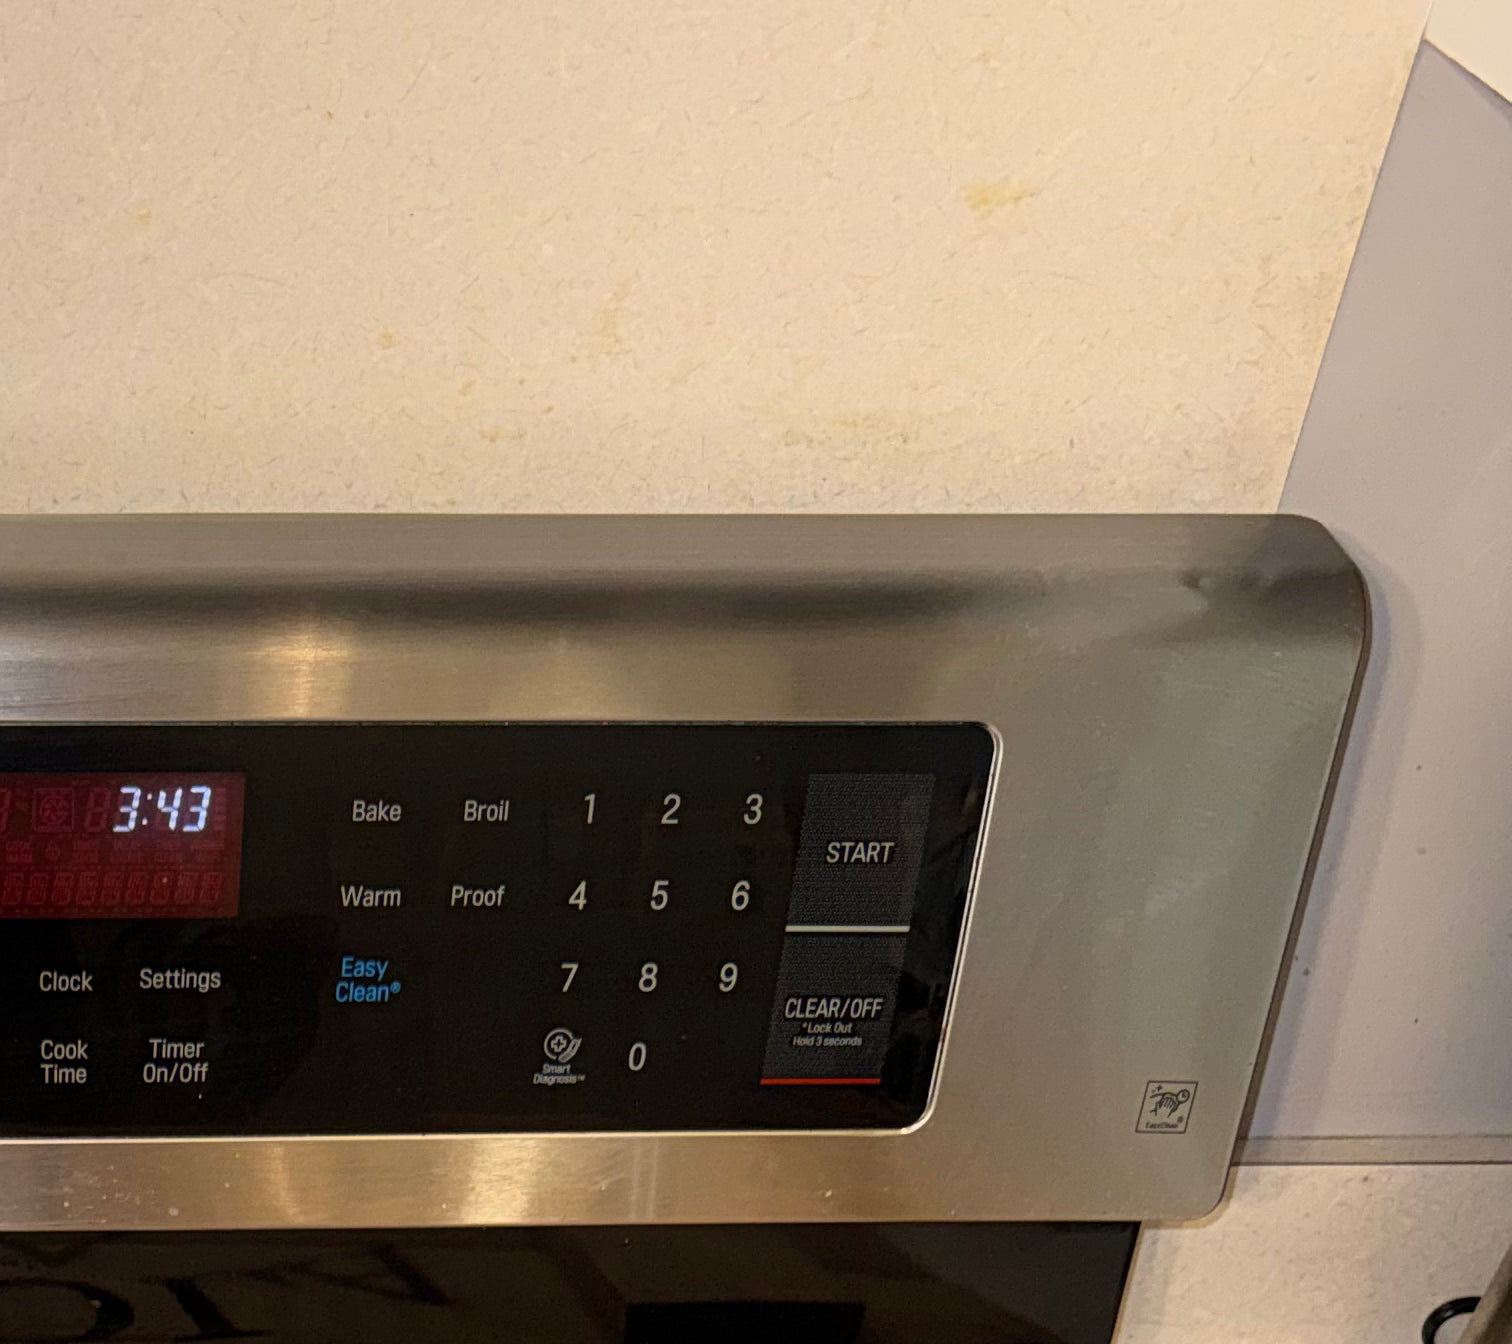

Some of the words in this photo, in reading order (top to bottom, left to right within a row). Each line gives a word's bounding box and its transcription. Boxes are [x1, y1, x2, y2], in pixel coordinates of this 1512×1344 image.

[113, 786, 211, 832] 3:43
[352, 800, 402, 822] Bake
[463, 800, 510, 822] Broil
[584, 794, 596, 825] 1
[660, 794, 682, 825] 2
[743, 794, 763, 825] 3
[826, 841, 895, 863] START
[340, 885, 401, 907] Warm
[451, 885, 506, 907] Proof
[568, 880, 587, 911] 4
[650, 880, 669, 911] 5
[731, 880, 750, 911] 6
[341, 956, 389, 981] Easy
[561, 962, 579, 992] 7
[638, 962, 658, 993] 8
[718, 962, 738, 993] 9
[39, 970, 93, 992] Clock
[140, 968, 221, 993] Settings
[785, 998, 884, 1018] CLEAR/OFF
[834, 1022, 853, 1033] Out
[40, 1039, 88, 1060] Cook
[149, 1038, 205, 1059] Timer
[793, 1036, 814, 1046] Hold
[816, 1036, 822, 1046] 3
[628, 1042, 647, 1071] 0
[40, 1064, 87, 1084] Time
[143, 1062, 208, 1083] On/Off
[542, 1063, 571, 1074] Smart
